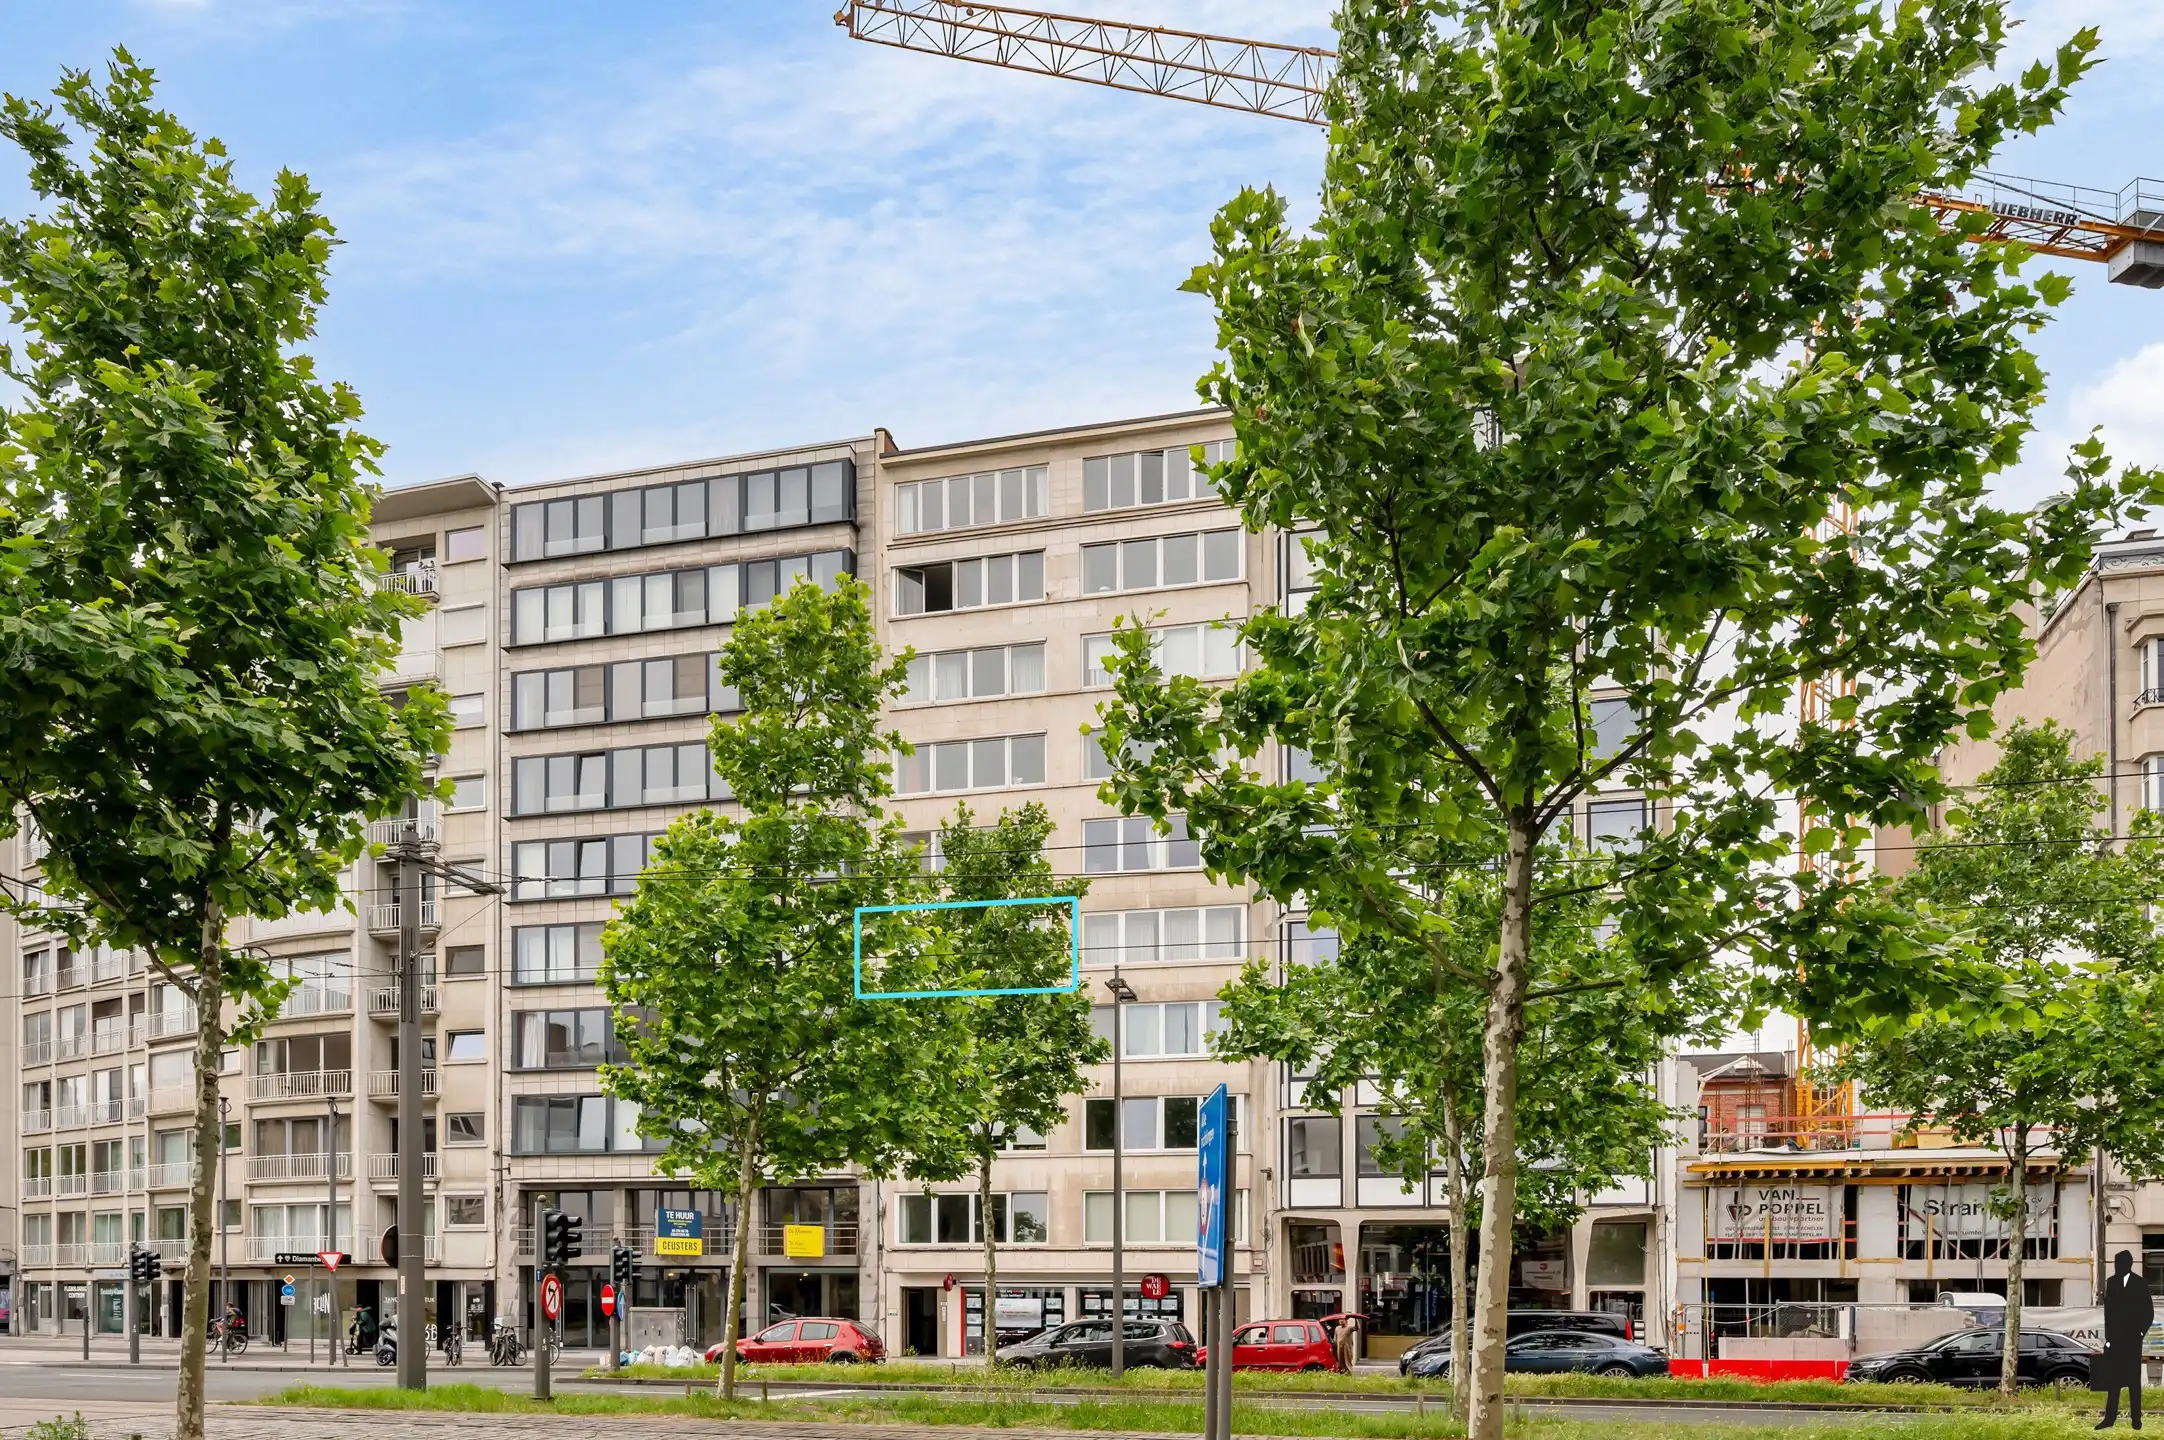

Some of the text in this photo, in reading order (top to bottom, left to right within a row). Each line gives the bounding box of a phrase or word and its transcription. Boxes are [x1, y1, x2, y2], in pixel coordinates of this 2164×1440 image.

[1991, 202, 2076, 226] LIEBHERR
[1758, 1189, 1795, 1201] VAN
[1759, 1203, 1825, 1215] POPPEL
[666, 1210, 695, 1220] TE HUUR
[662, 1240, 698, 1251] CEUSTERS
[1151, 1276, 1162, 1284] DE
